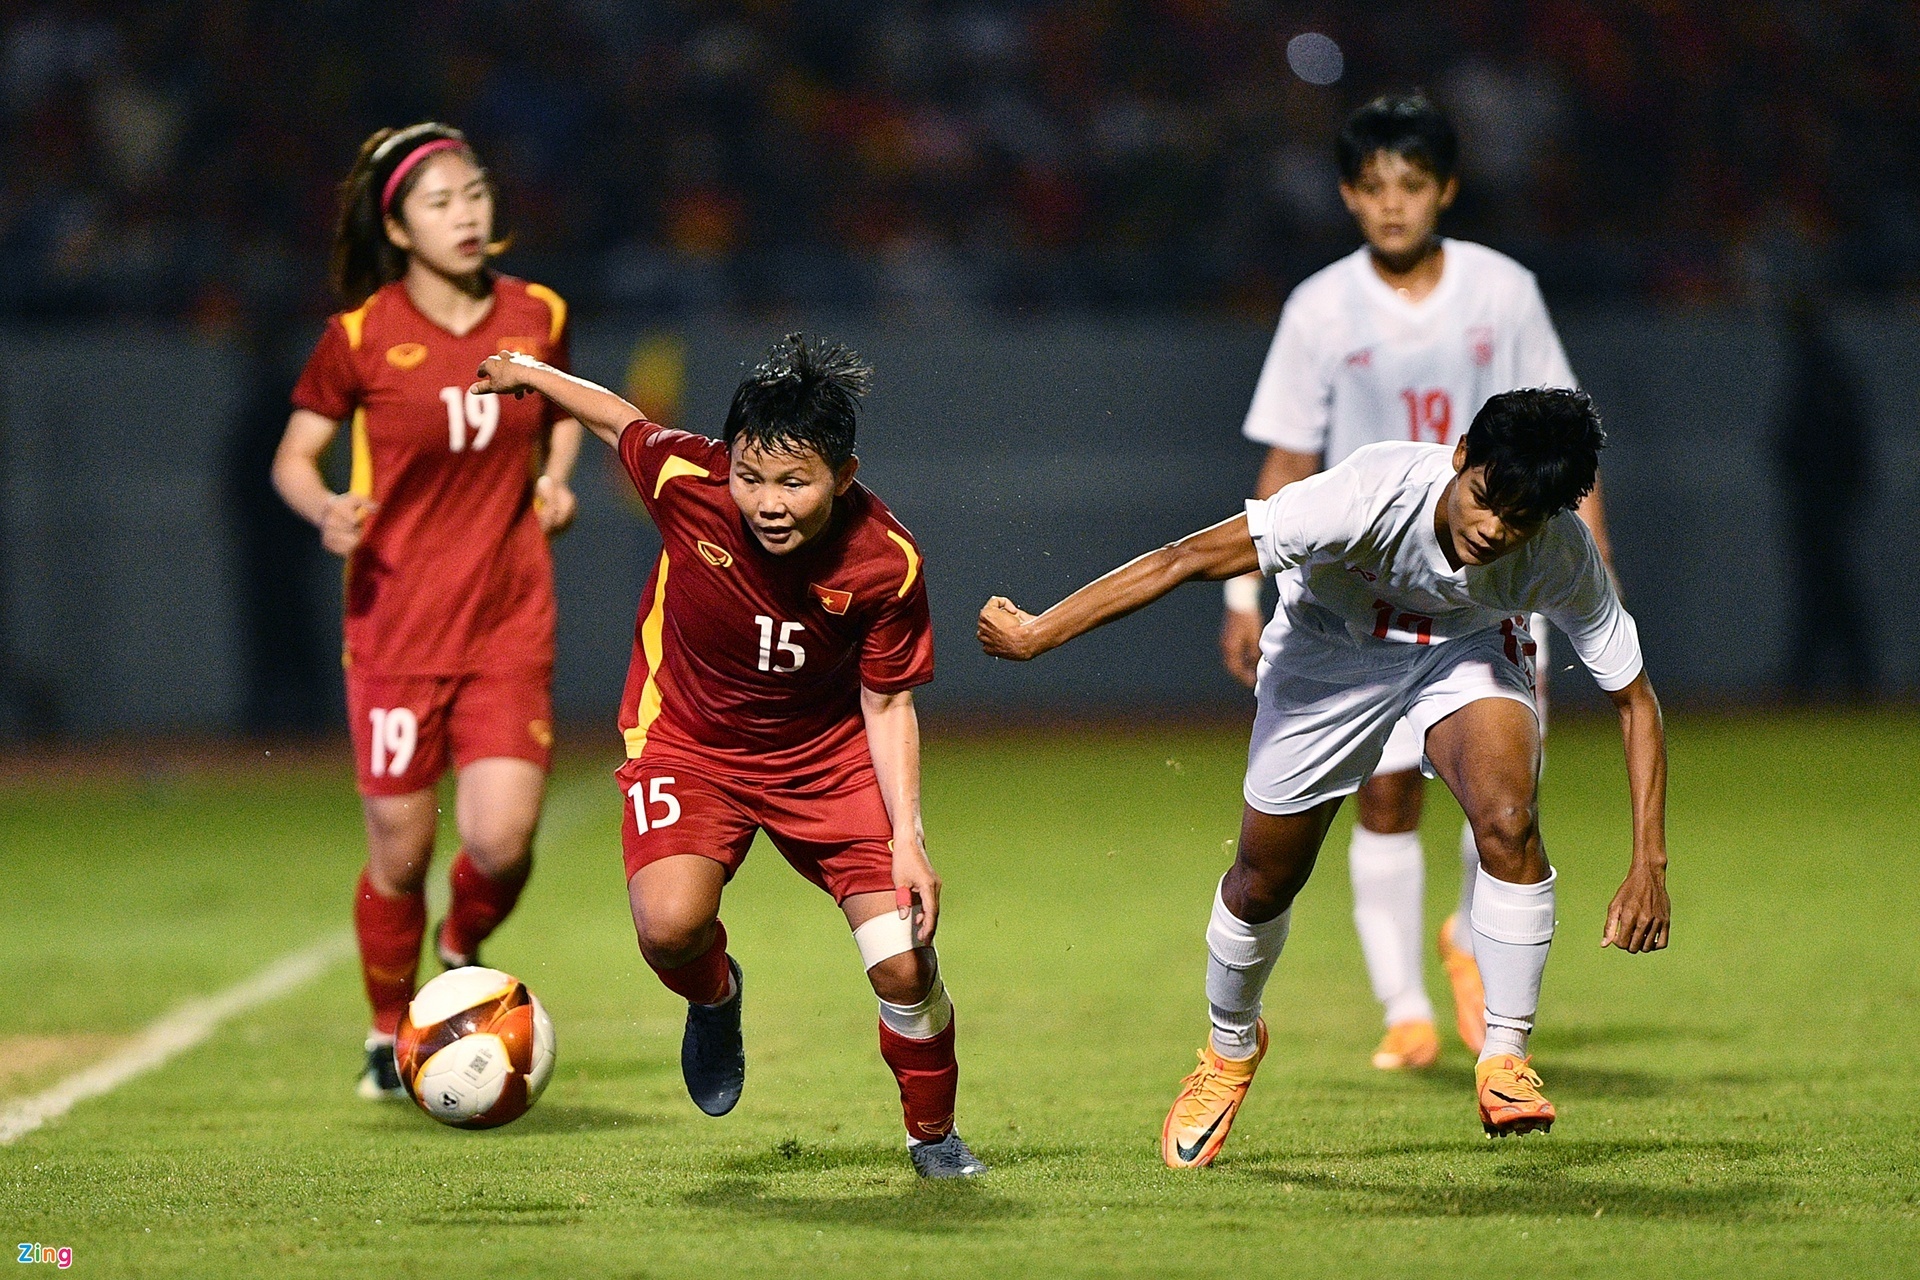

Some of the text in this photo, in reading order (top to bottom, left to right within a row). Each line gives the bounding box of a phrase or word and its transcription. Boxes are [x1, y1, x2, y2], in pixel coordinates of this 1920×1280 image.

[439, 385, 500, 453] 19
[1400, 387, 1451, 444] 19
[754, 614, 806, 673] 15
[368, 706, 418, 778] 19
[627, 776, 681, 836] 15
